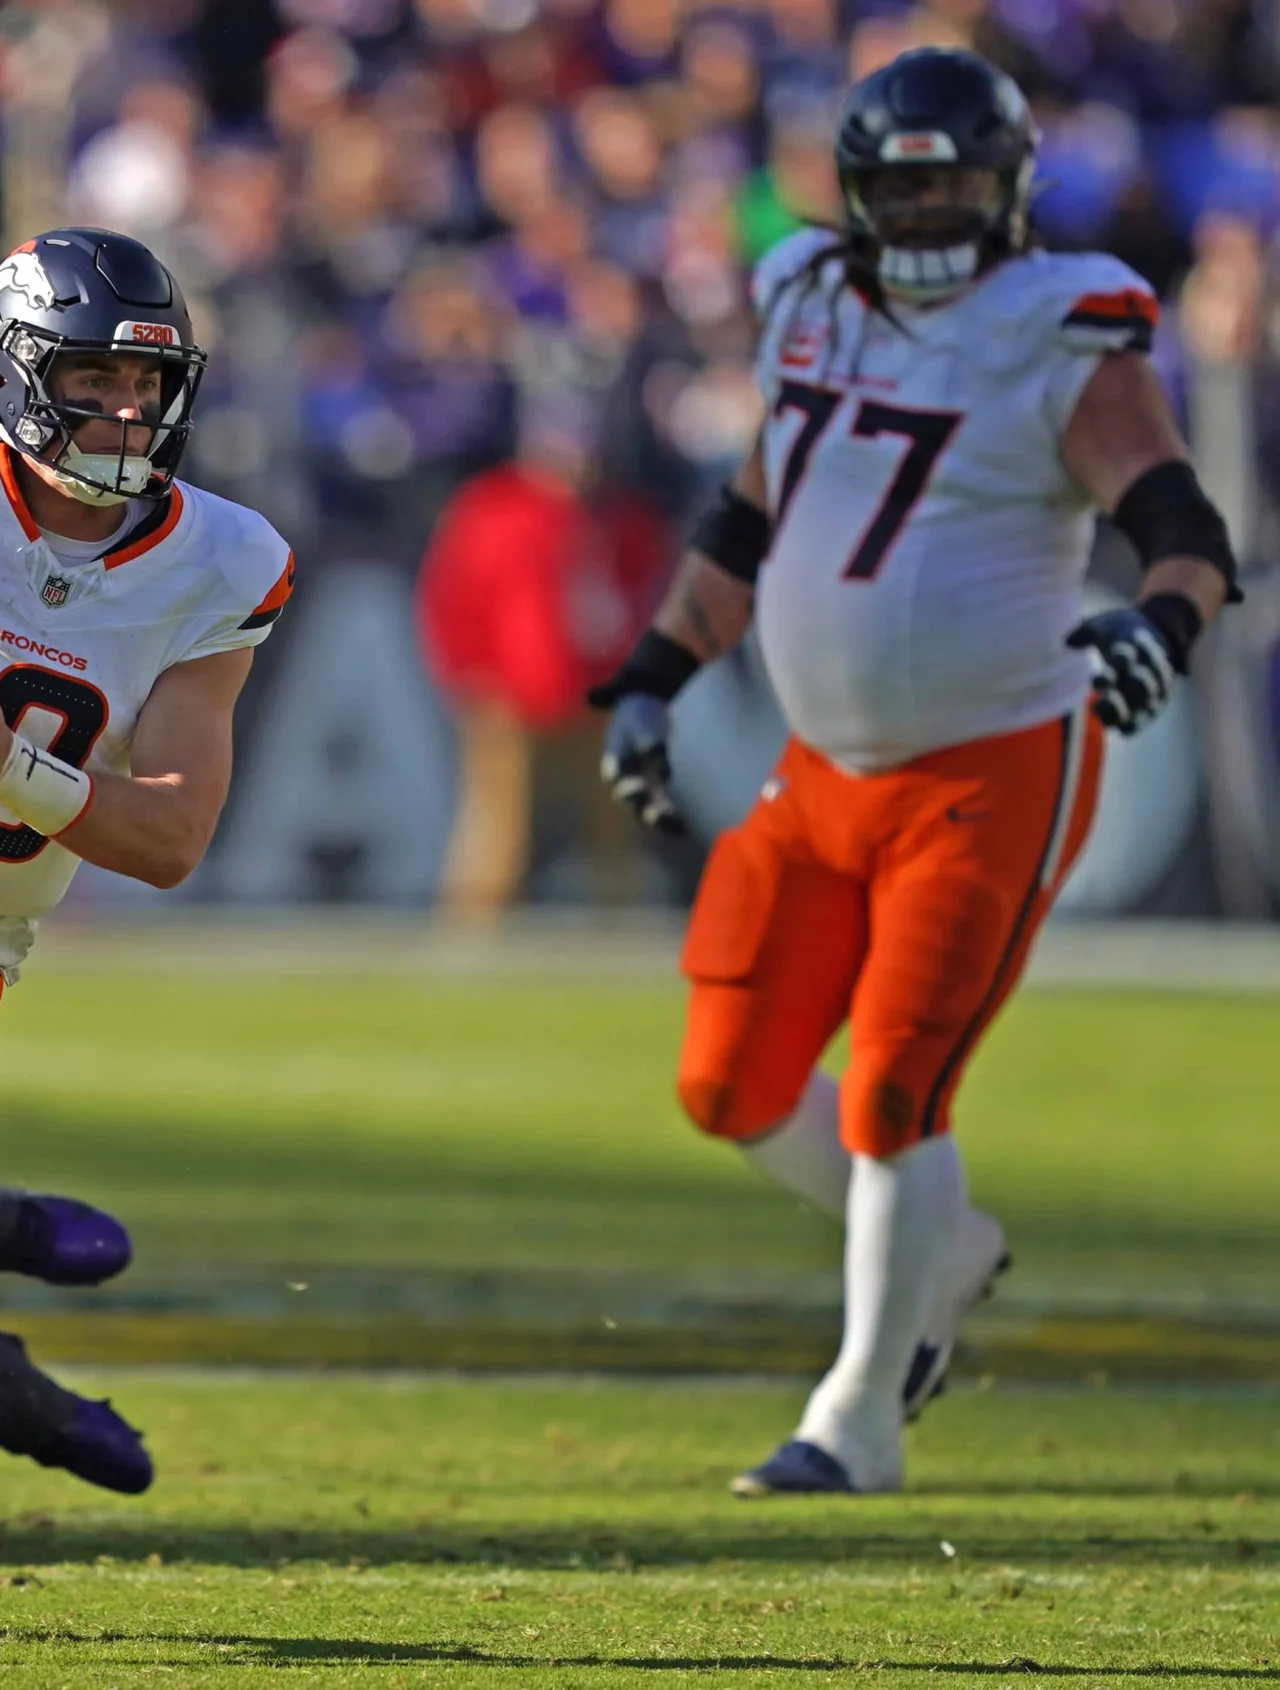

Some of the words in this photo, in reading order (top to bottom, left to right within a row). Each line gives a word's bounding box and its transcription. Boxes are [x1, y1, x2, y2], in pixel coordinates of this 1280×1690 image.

[132, 323, 174, 346] 5280
[766, 379, 968, 582] 77
[43, 587, 64, 604] NFL
